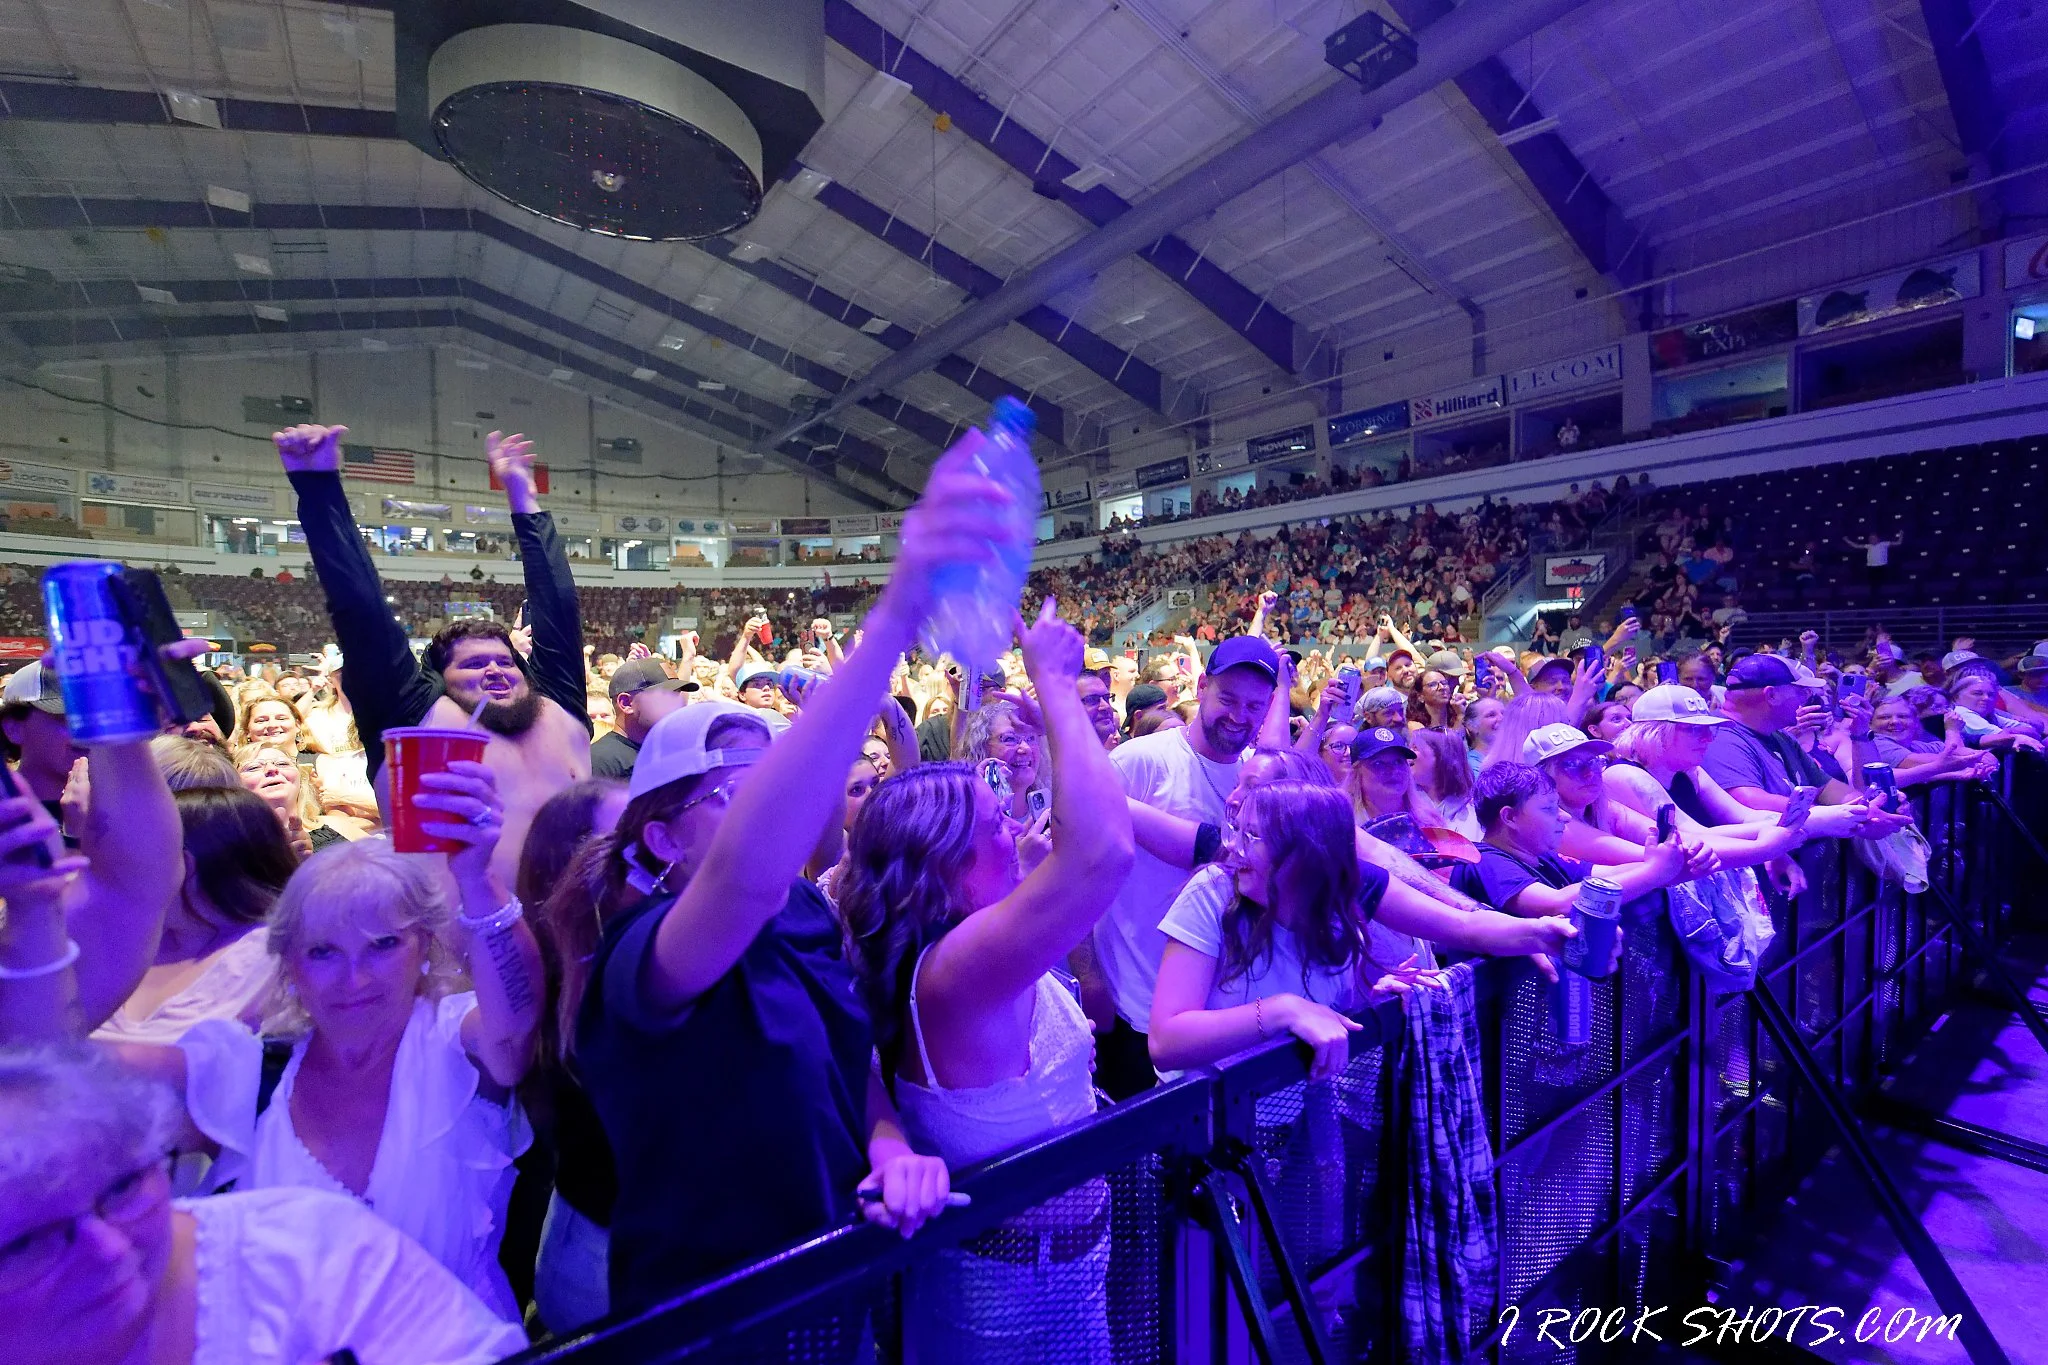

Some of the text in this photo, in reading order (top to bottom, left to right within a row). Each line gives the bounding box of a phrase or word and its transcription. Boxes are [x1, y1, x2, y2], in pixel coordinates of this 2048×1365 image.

[1513, 352, 1615, 393] LECOM
[1435, 387, 1499, 416] Hilliard
[1336, 410, 1396, 433] CORNING
[61, 619, 125, 647] UD
[1568, 979, 1581, 1013] LIGHT
[1568, 1013, 1581, 1038] BUD
